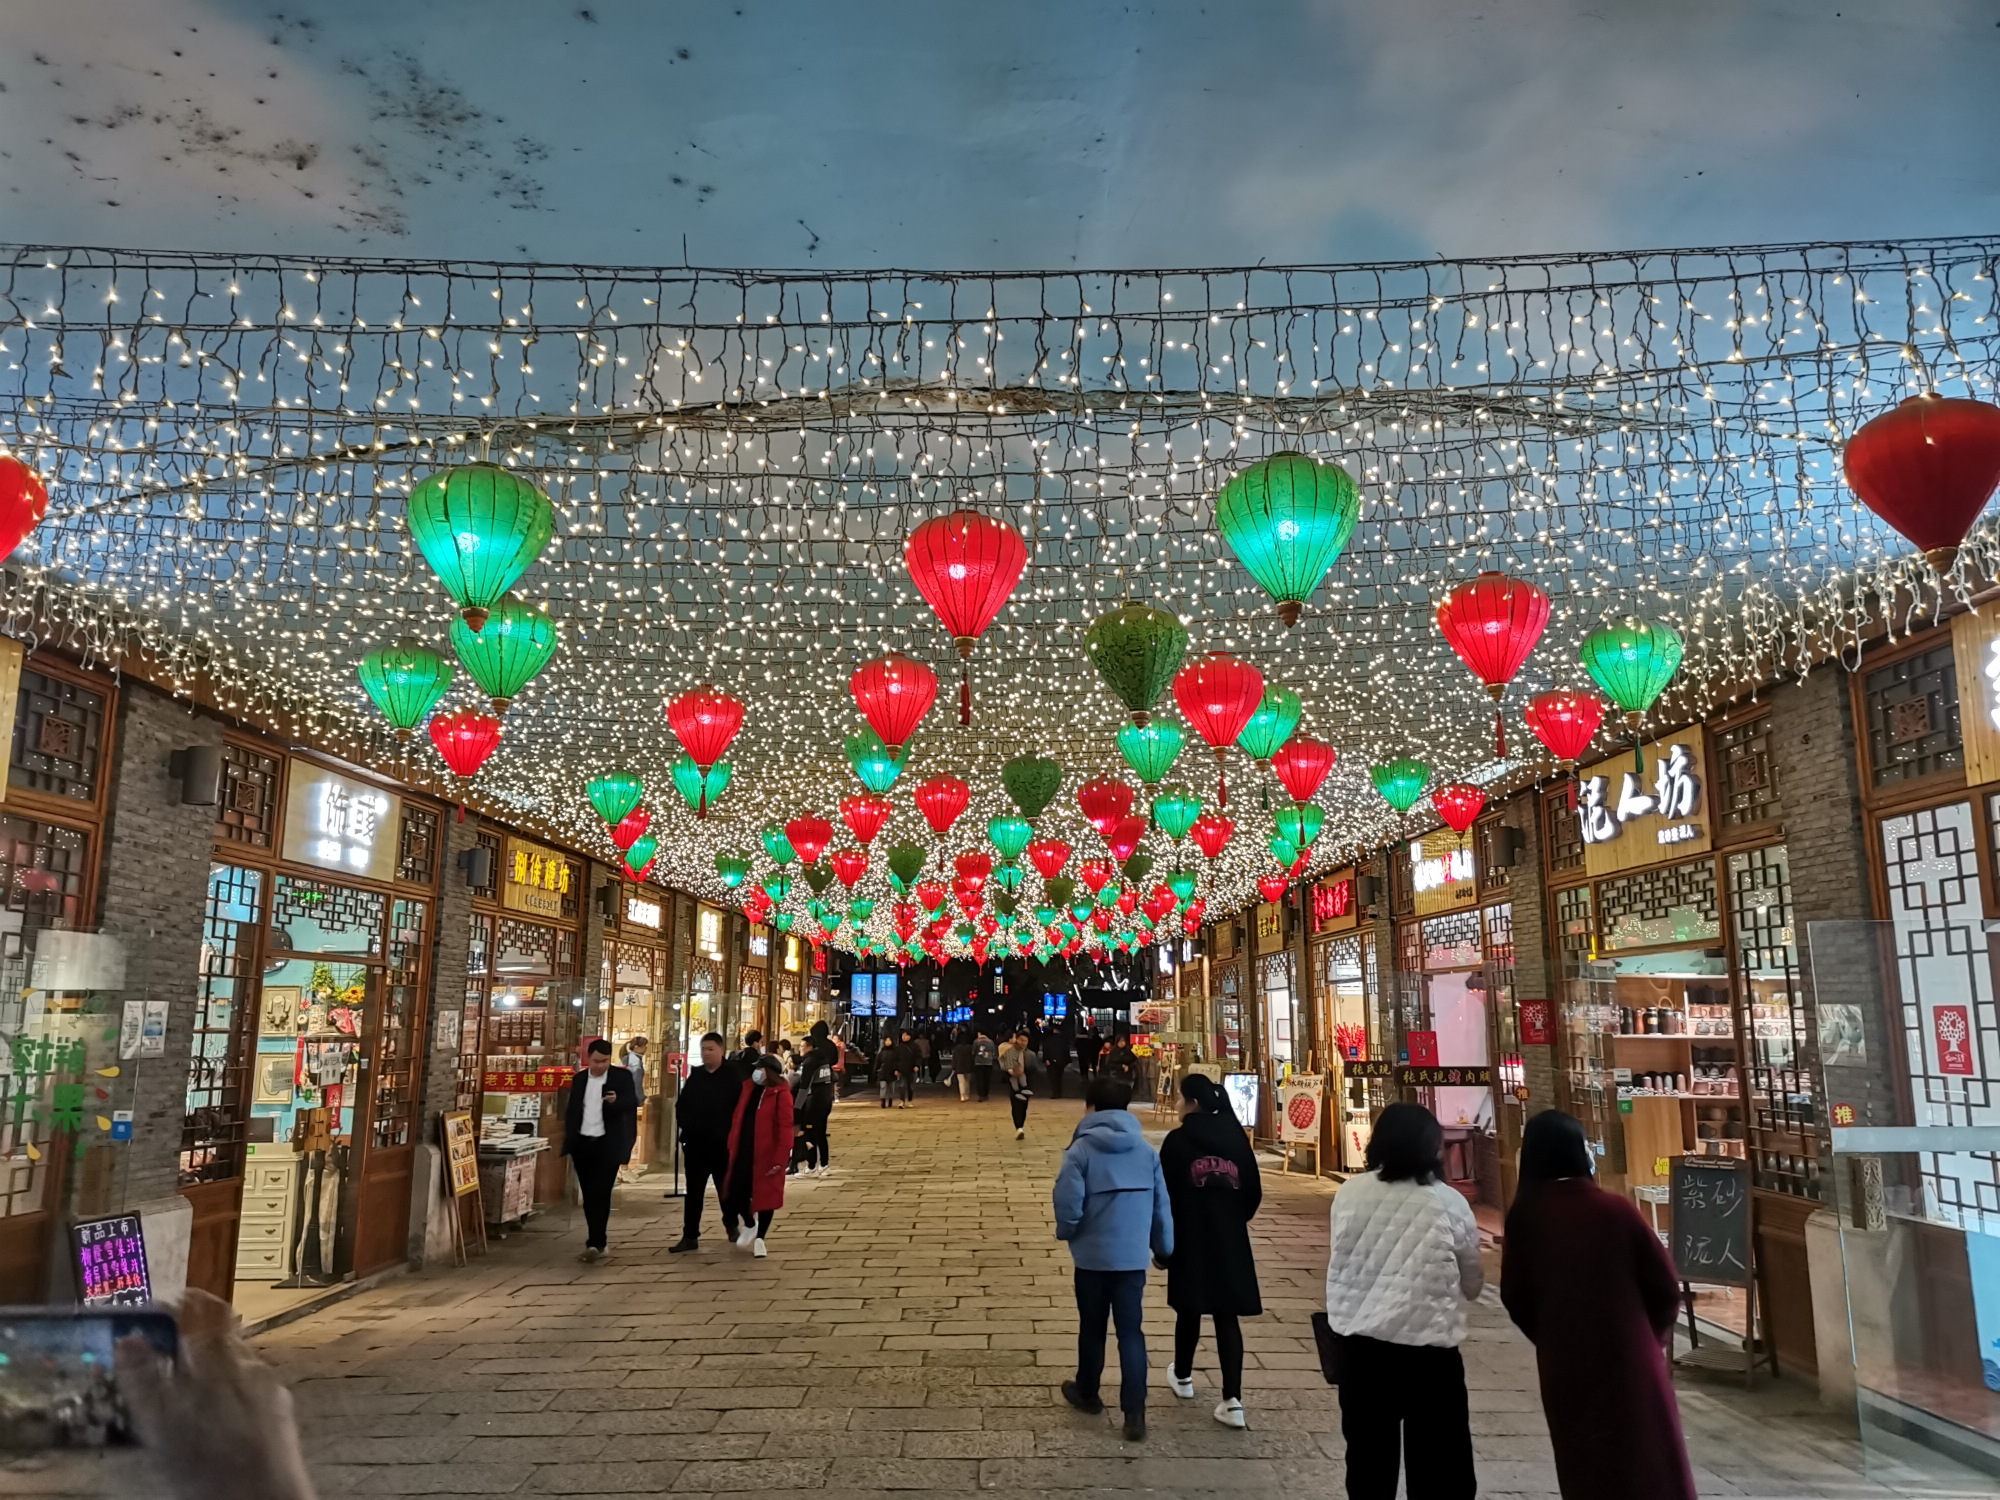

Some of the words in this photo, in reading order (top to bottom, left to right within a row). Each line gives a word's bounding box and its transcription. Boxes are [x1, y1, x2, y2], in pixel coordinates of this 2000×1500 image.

[1578, 744, 1697, 844] 泥人坊
[1352, 1062, 1391, 1076] 张氏现
[485, 1073, 573, 1087] 老无锡特产
[1517, 1088, 1529, 1100] 推
[1834, 1105, 1854, 1125] 推
[1681, 1174, 1743, 1218] 紫砂
[81, 1221, 129, 1245] 新品上市
